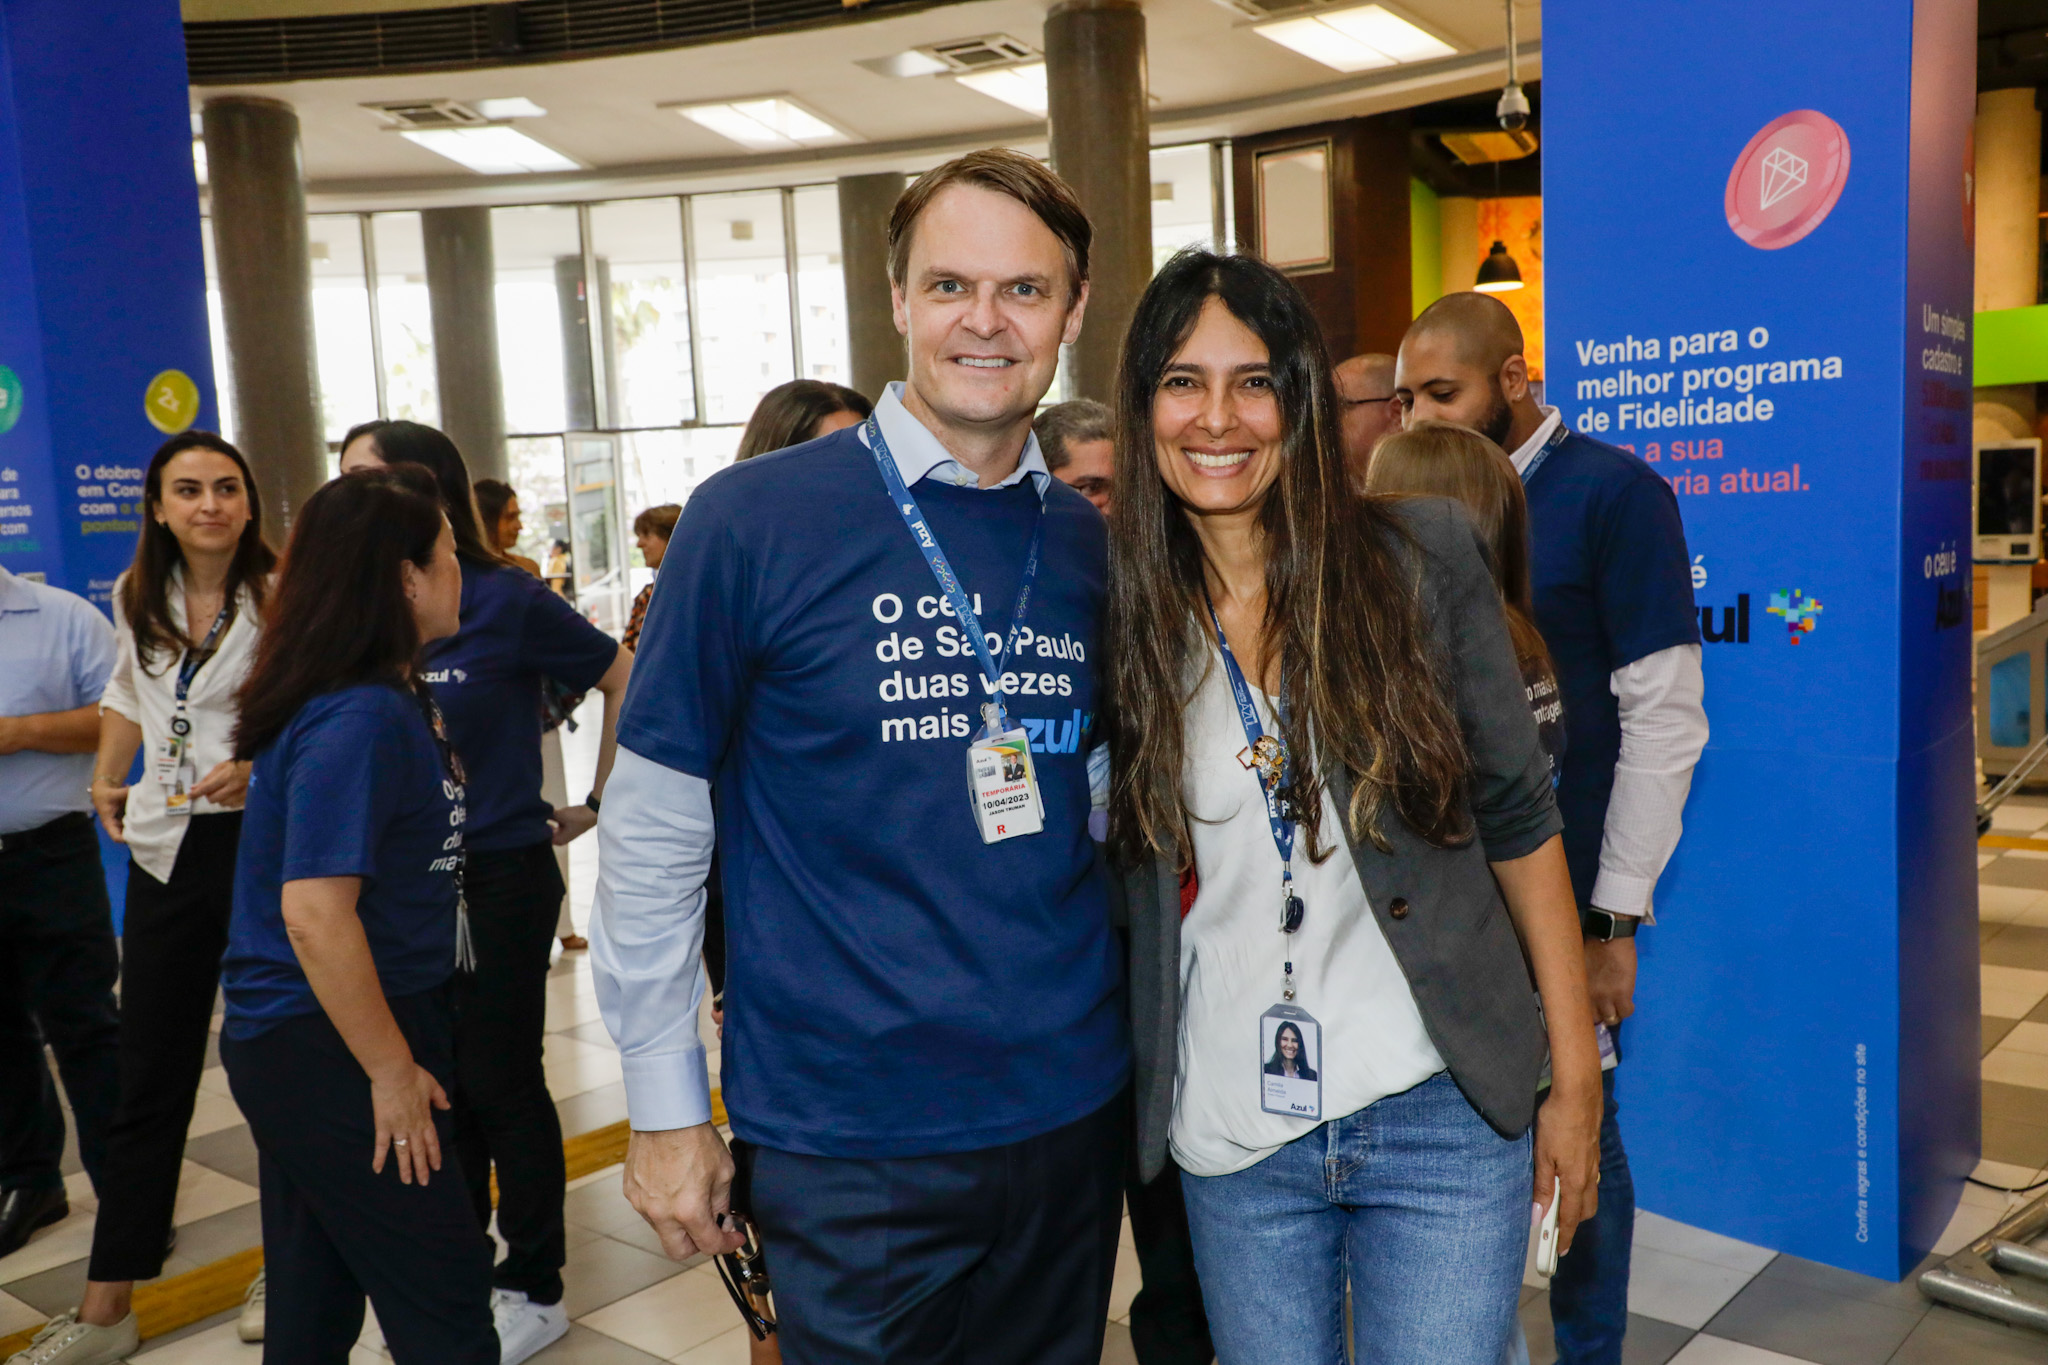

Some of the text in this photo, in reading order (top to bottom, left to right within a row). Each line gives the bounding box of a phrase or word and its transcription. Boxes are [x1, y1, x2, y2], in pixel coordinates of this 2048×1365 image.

[1922, 304, 1940, 333] Um
[1576, 326, 1770, 367] Venha para o
[1577, 355, 1843, 400] melhor programa
[1577, 393, 1775, 433] de Fidelidade
[1644, 442, 1661, 462] a
[1669, 437, 1723, 461] sua
[75, 464, 144, 480] O dobro
[1662, 463, 1810, 495] ria atual.
[77, 485, 105, 497] em
[0, 504, 33, 517] ersos
[79, 502, 117, 515] com
[911, 520, 935, 548] Azul
[1690, 554, 1708, 589] é
[872, 592, 903, 624] O
[875, 632, 924, 663] de
[1014, 626, 1085, 663] Paulo
[879, 670, 1072, 702] duas vezes
[1239, 701, 1256, 730] AZUL
[881, 707, 1081, 753] mais zul
[442, 780, 455, 800] O
[983, 793, 1029, 810] 10/04/2023
[996, 824, 1006, 835] R
[428, 855, 458, 871] ma
[1856, 1067, 1866, 1084] no
[1290, 1103, 1307, 1112] Azul
[1856, 1199, 1869, 1243] Confira
